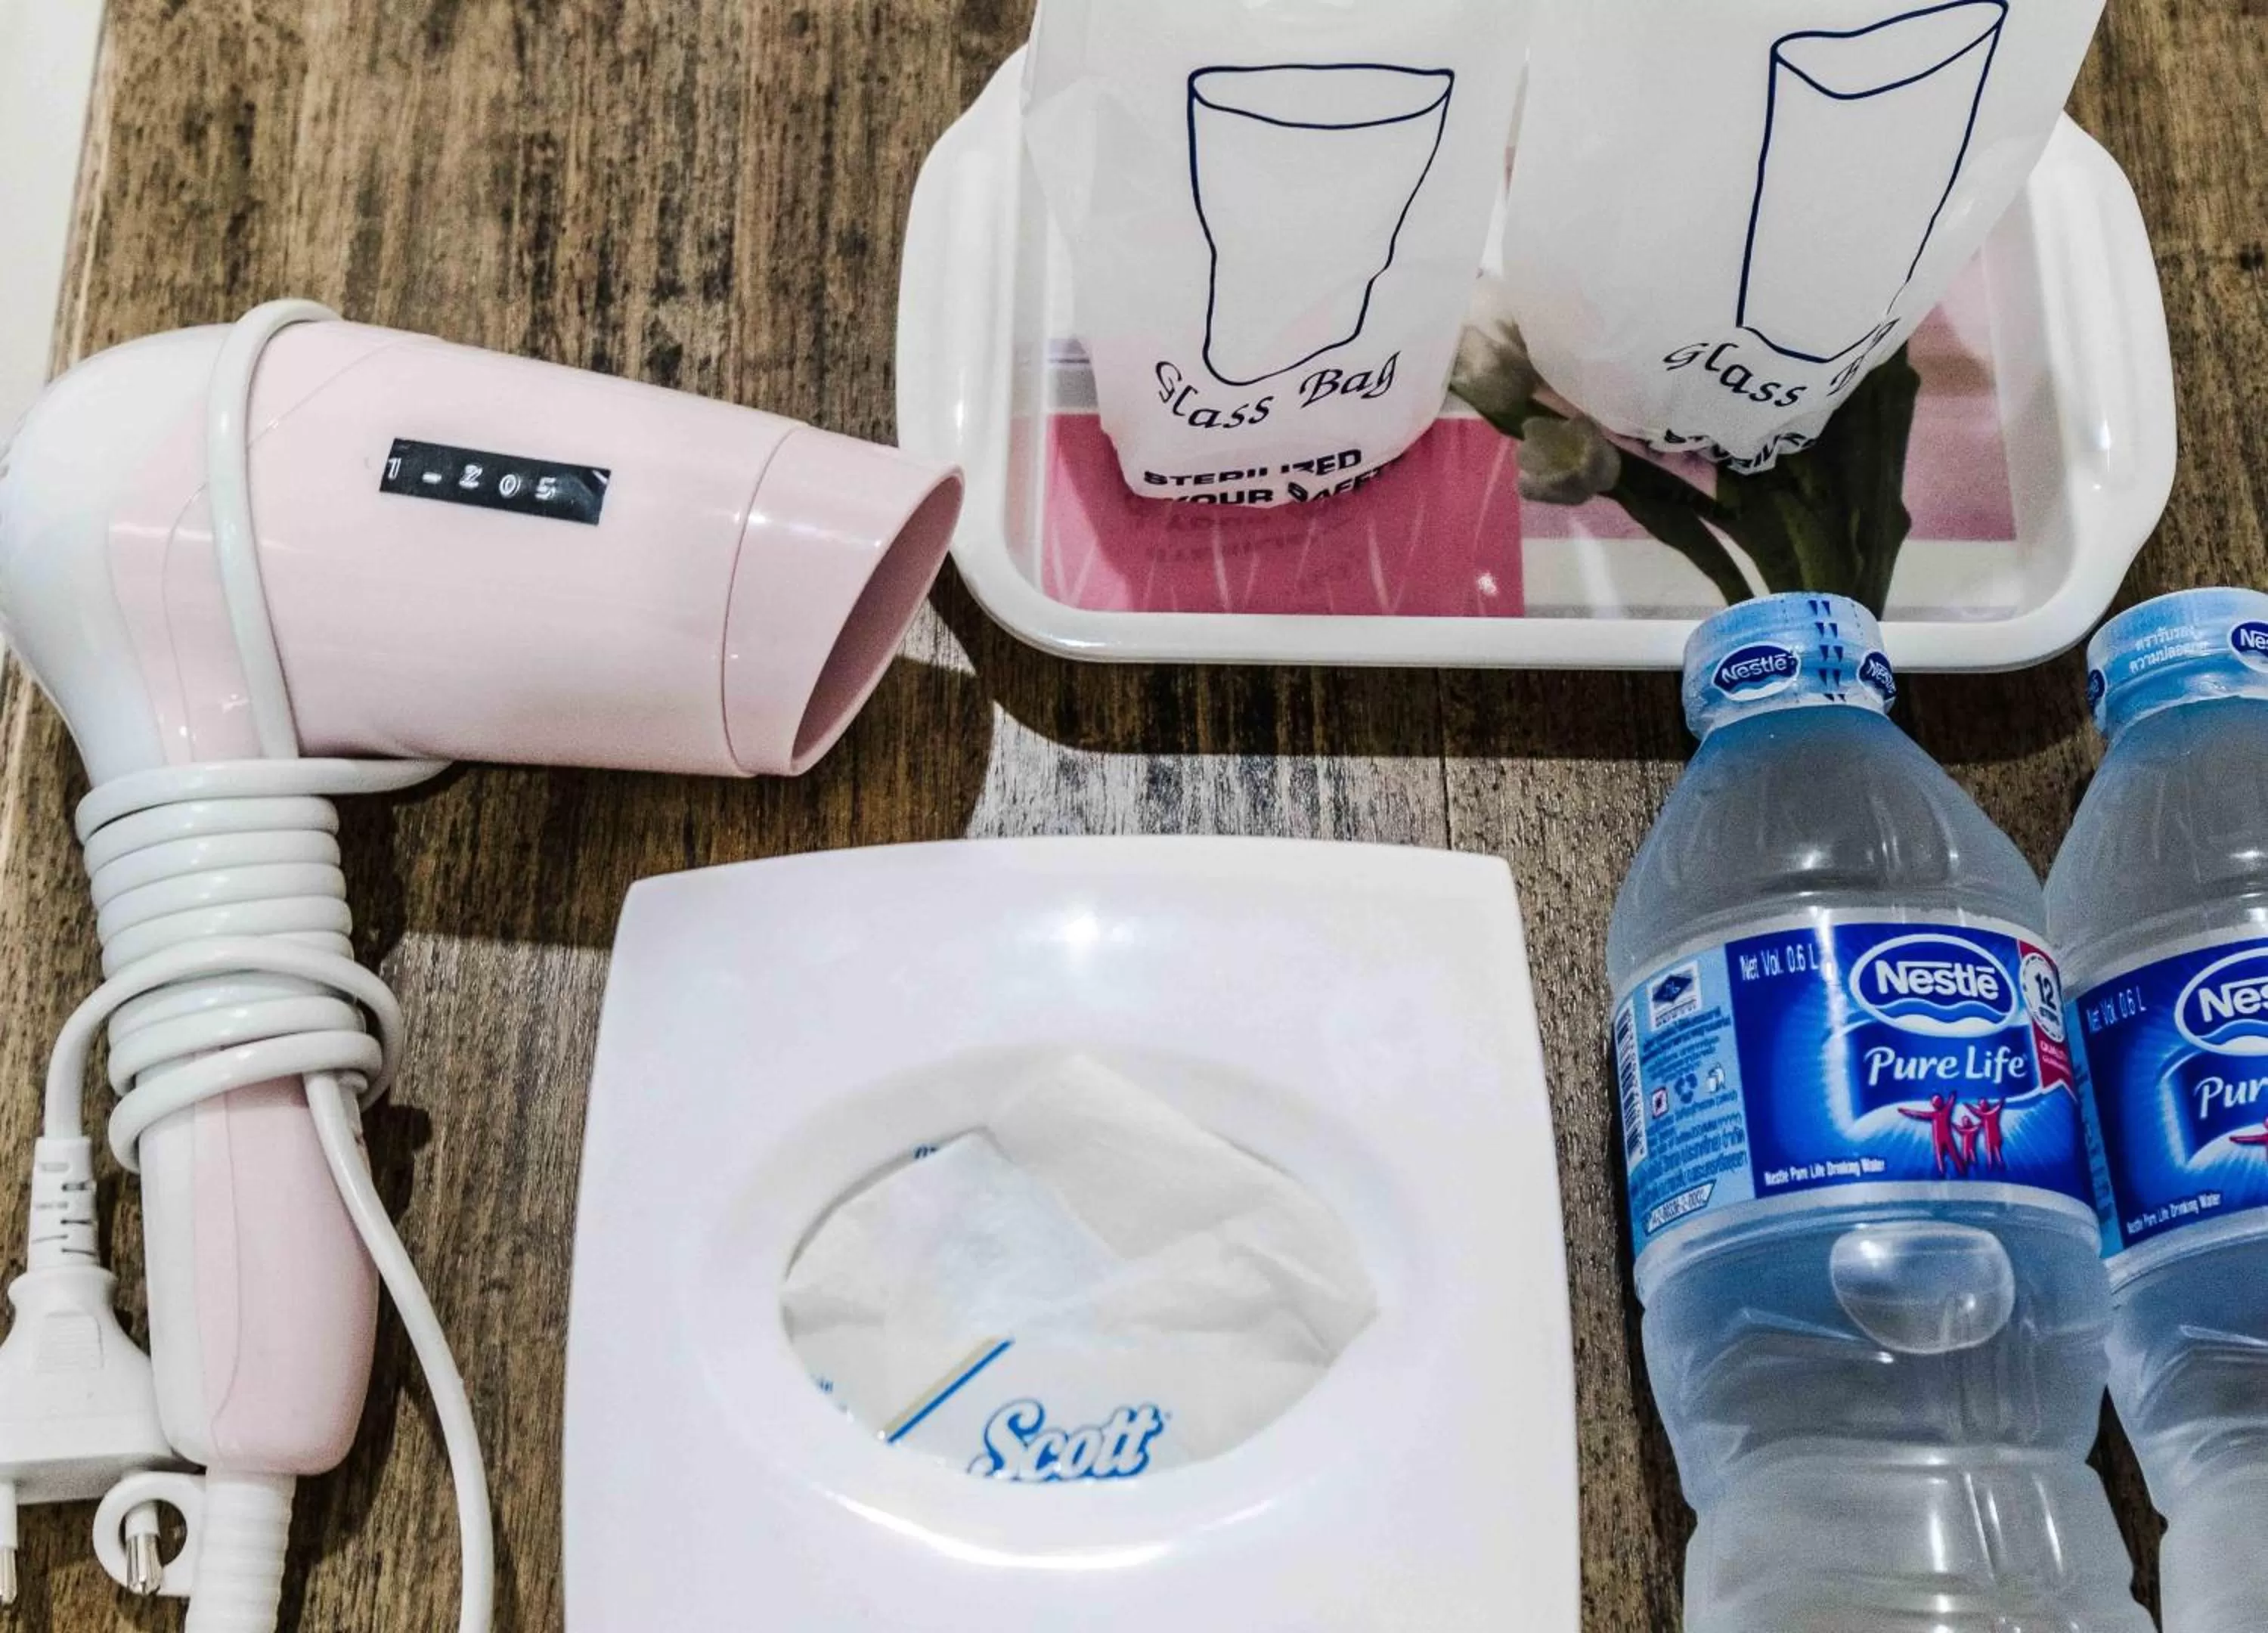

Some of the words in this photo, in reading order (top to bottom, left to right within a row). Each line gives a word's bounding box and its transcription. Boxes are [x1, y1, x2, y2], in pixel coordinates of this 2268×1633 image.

[1155, 361, 1274, 429] Glass
[1300, 351, 1401, 408] Bag
[1663, 342, 1807, 407] Glass
[2240, 627, 2268, 650] Ne
[1864, 1046, 1960, 1087] Pure
[1965, 1045, 2027, 1084] Life
[966, 1397, 1165, 1483] Scott
